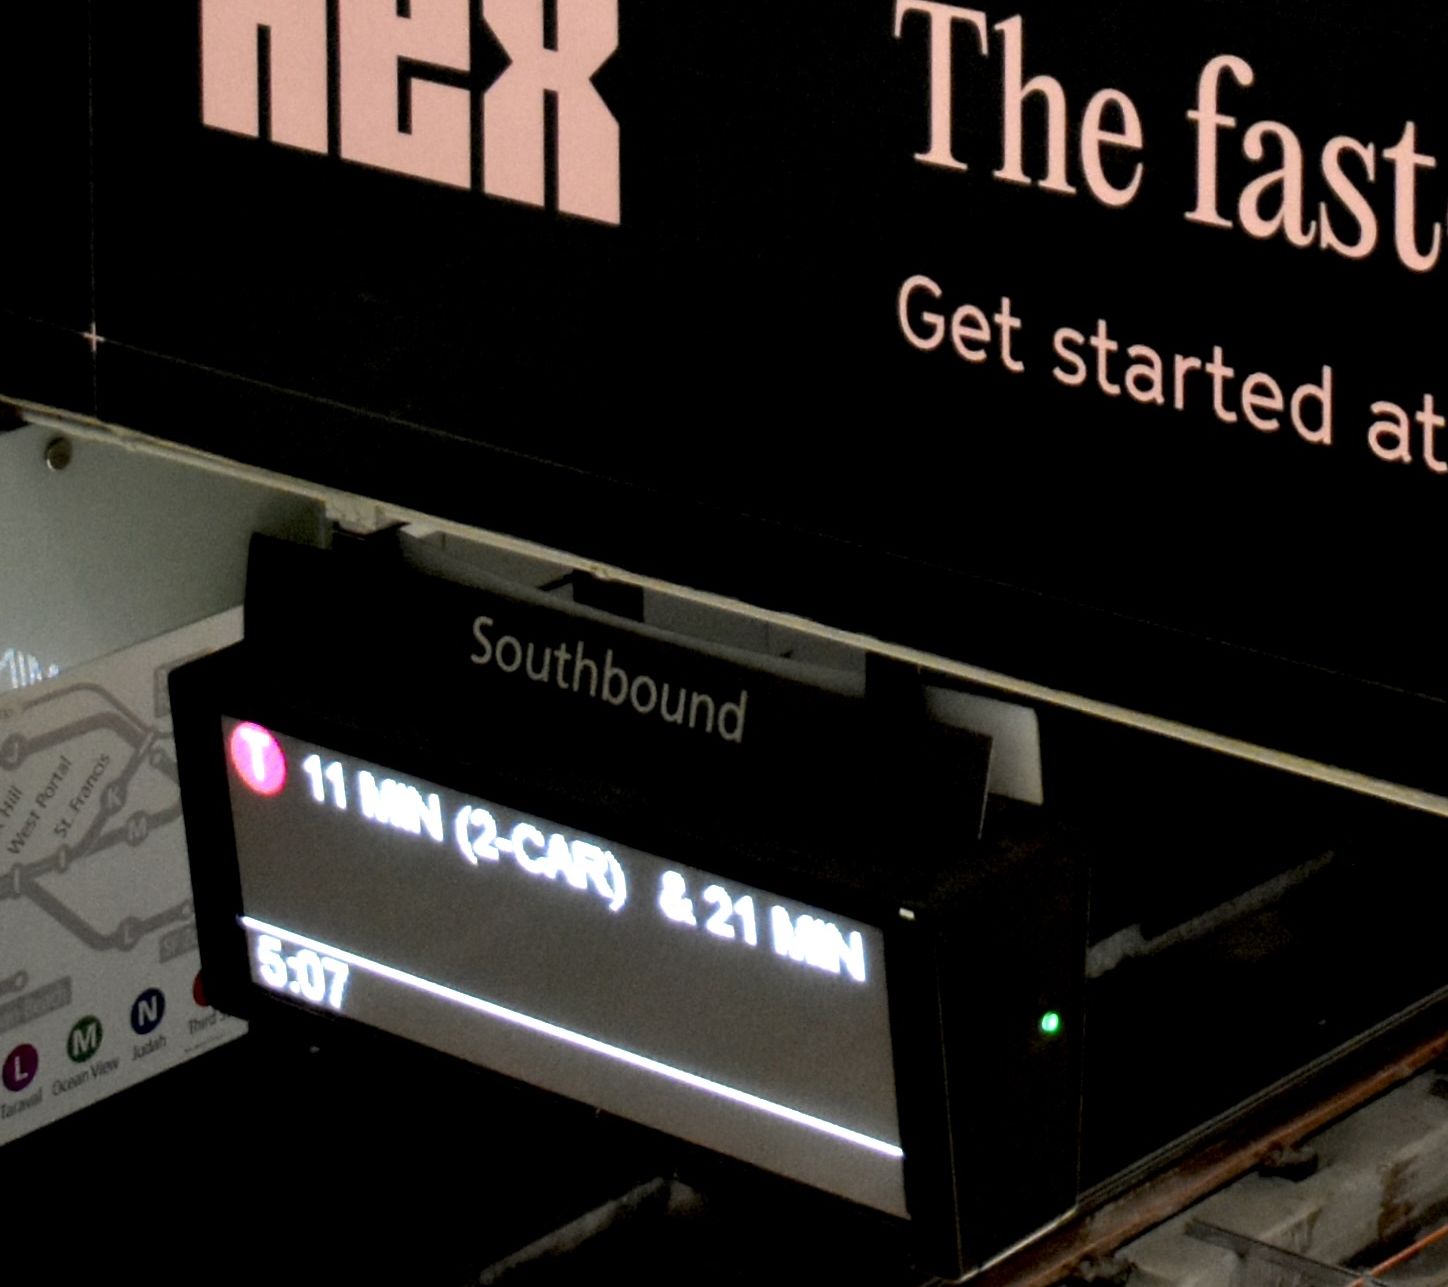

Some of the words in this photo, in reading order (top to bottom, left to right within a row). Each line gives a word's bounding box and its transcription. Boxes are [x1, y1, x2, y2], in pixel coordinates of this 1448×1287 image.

[899, 276, 1023, 371] Get
[1054, 320, 1331, 444] started
[1369, 395, 1447, 471] at
[470, 614, 748, 743] Southbound
[6, 811, 41, 855] West
[35, 754, 73, 809] Portal
[302, 753, 347, 811] 11
[358, 769, 444, 843] MIN
[453, 803, 629, 913] (2-CAR)
[657, 870, 697, 928] &
[703, 883, 756, 946] 21
[771, 904, 865, 983] MIN
[256, 938, 350, 1010] 5:07
